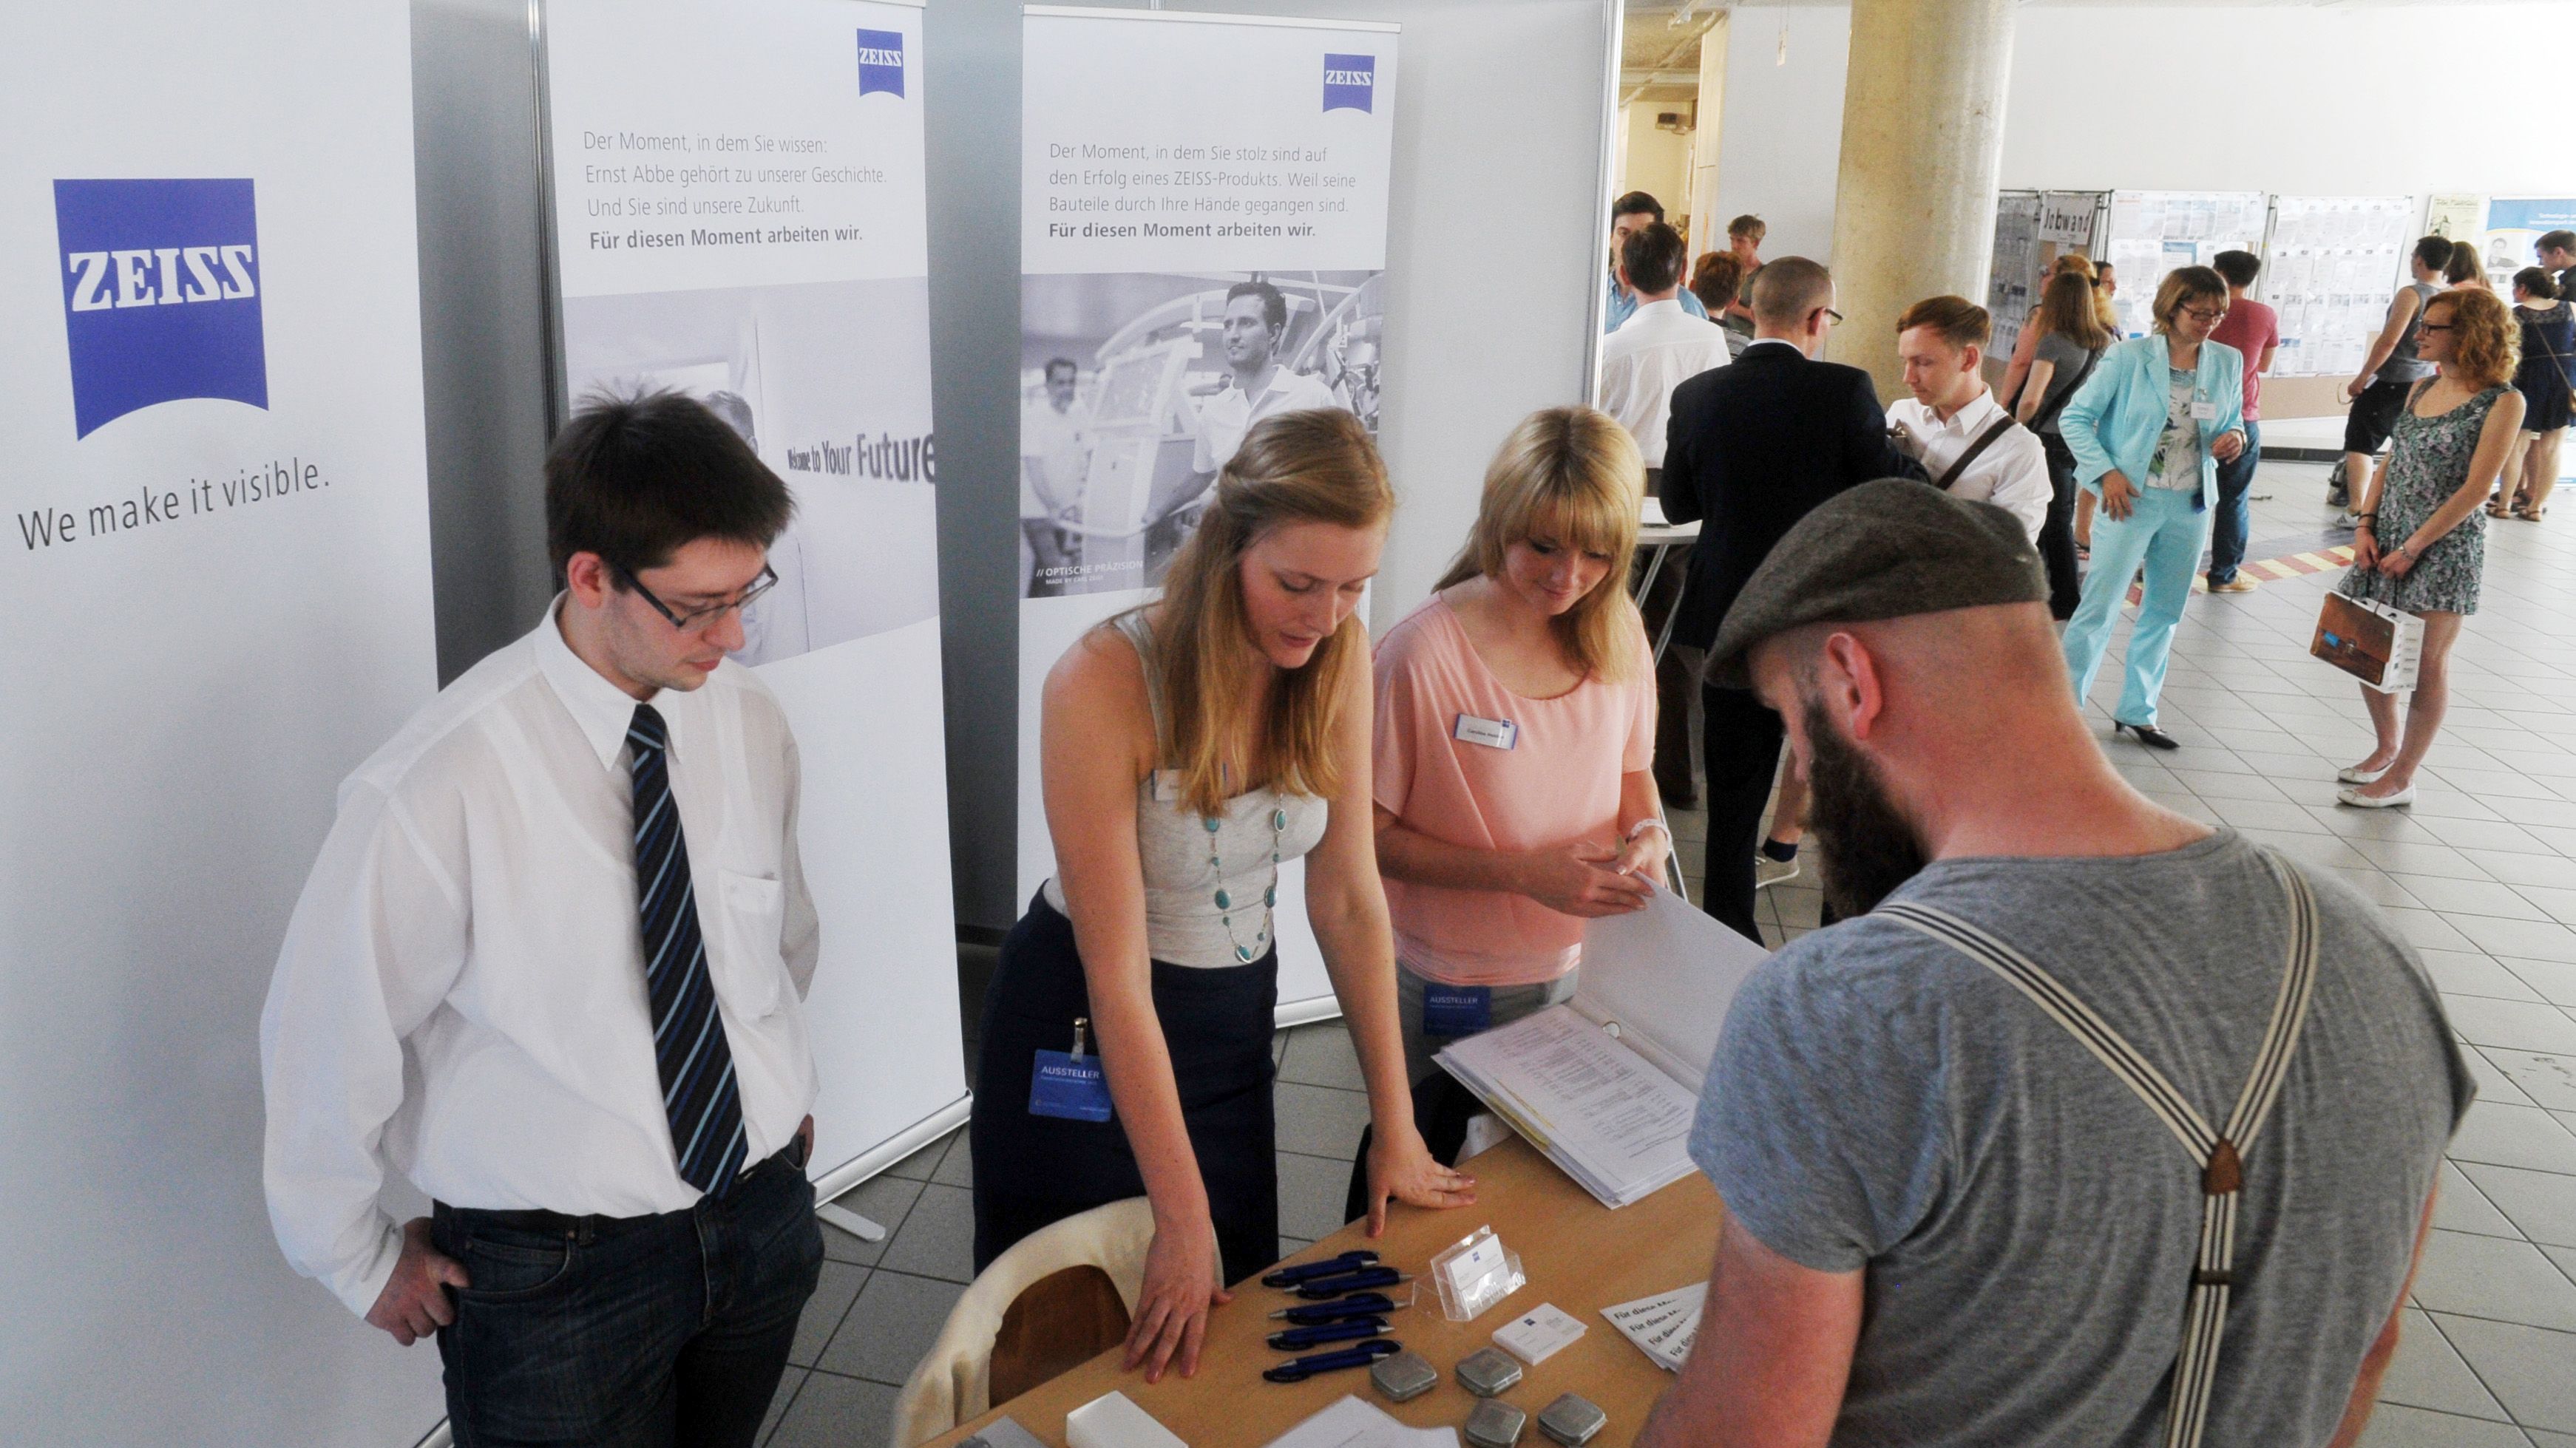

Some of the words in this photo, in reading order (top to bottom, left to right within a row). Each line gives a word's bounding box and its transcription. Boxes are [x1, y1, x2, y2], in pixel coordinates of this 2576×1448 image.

[859, 47, 902, 67] ZEISS
[1326, 69, 1372, 86] ZEISS
[584, 132, 613, 150] Der
[620, 132, 691, 154] Moment,
[697, 134, 710, 151] in
[716, 134, 749, 152] dem
[755, 135, 774, 152] Sie
[779, 136, 827, 154] wissen:
[1050, 143, 1076, 159] Der
[1082, 144, 1150, 161] Moment,
[1156, 144, 1168, 160] in
[1173, 145, 1205, 160] dem
[1211, 146, 1231, 161] Sie
[1236, 146, 1267, 162] stolz
[1272, 146, 1300, 163] sind
[1305, 147, 1328, 163] auf
[586, 165, 627, 183] Ernst
[633, 164, 674, 183] Abbe
[680, 165, 730, 188] gehört
[735, 169, 752, 183] zu
[759, 168, 807, 183] unserer
[812, 166, 887, 183] Geschichte.
[1049, 170, 1077, 186] den
[1084, 170, 1127, 189] Erfolg
[1132, 171, 1169, 186] eines
[1174, 171, 1283, 187] ZEISS-Produkts.
[1288, 172, 1318, 188] Weil
[1323, 174, 1357, 188] seine
[588, 198, 622, 217] Und
[628, 197, 651, 215] Sie
[657, 197, 688, 215] sind
[694, 198, 742, 214] unsere
[748, 194, 804, 214] Zukunft.
[1049, 197, 1110, 212] Bauteile
[1115, 197, 1156, 212] durch
[1162, 197, 1189, 212] Ihre
[1194, 197, 1241, 212] Hände
[1244, 200, 1315, 215] gegangen
[1318, 198, 1349, 213] sind.
[1049, 222, 1077, 238] Für
[1082, 222, 1137, 237] diesen
[1144, 223, 1212, 237] Moment
[1217, 222, 1282, 237] arbeiten
[1287, 222, 1316, 237] wir.
[2044, 208, 2092, 232] Jobwand
[590, 231, 620, 250] Für
[626, 230, 685, 248] diesen
[691, 227, 762, 246] Moment
[767, 225, 829, 244] arbeiten
[835, 225, 863, 241] wir.
[68, 244, 255, 312] ZEISS
[811, 445, 821, 473] to
[821, 440, 851, 475] Your
[857, 432, 935, 483] Future
[18, 507, 76, 551] We
[89, 486, 180, 537] make
[191, 479, 214, 514] it
[223, 457, 330, 508] visible.
[1045, 565, 1093, 577] OPTISCHE
[1430, 996, 1478, 1005] AUSSTELLER
[1041, 1065, 1099, 1079] AUSSTELLER
[1613, 1311, 1630, 1320] Für
[1629, 1322, 1645, 1333] Für
